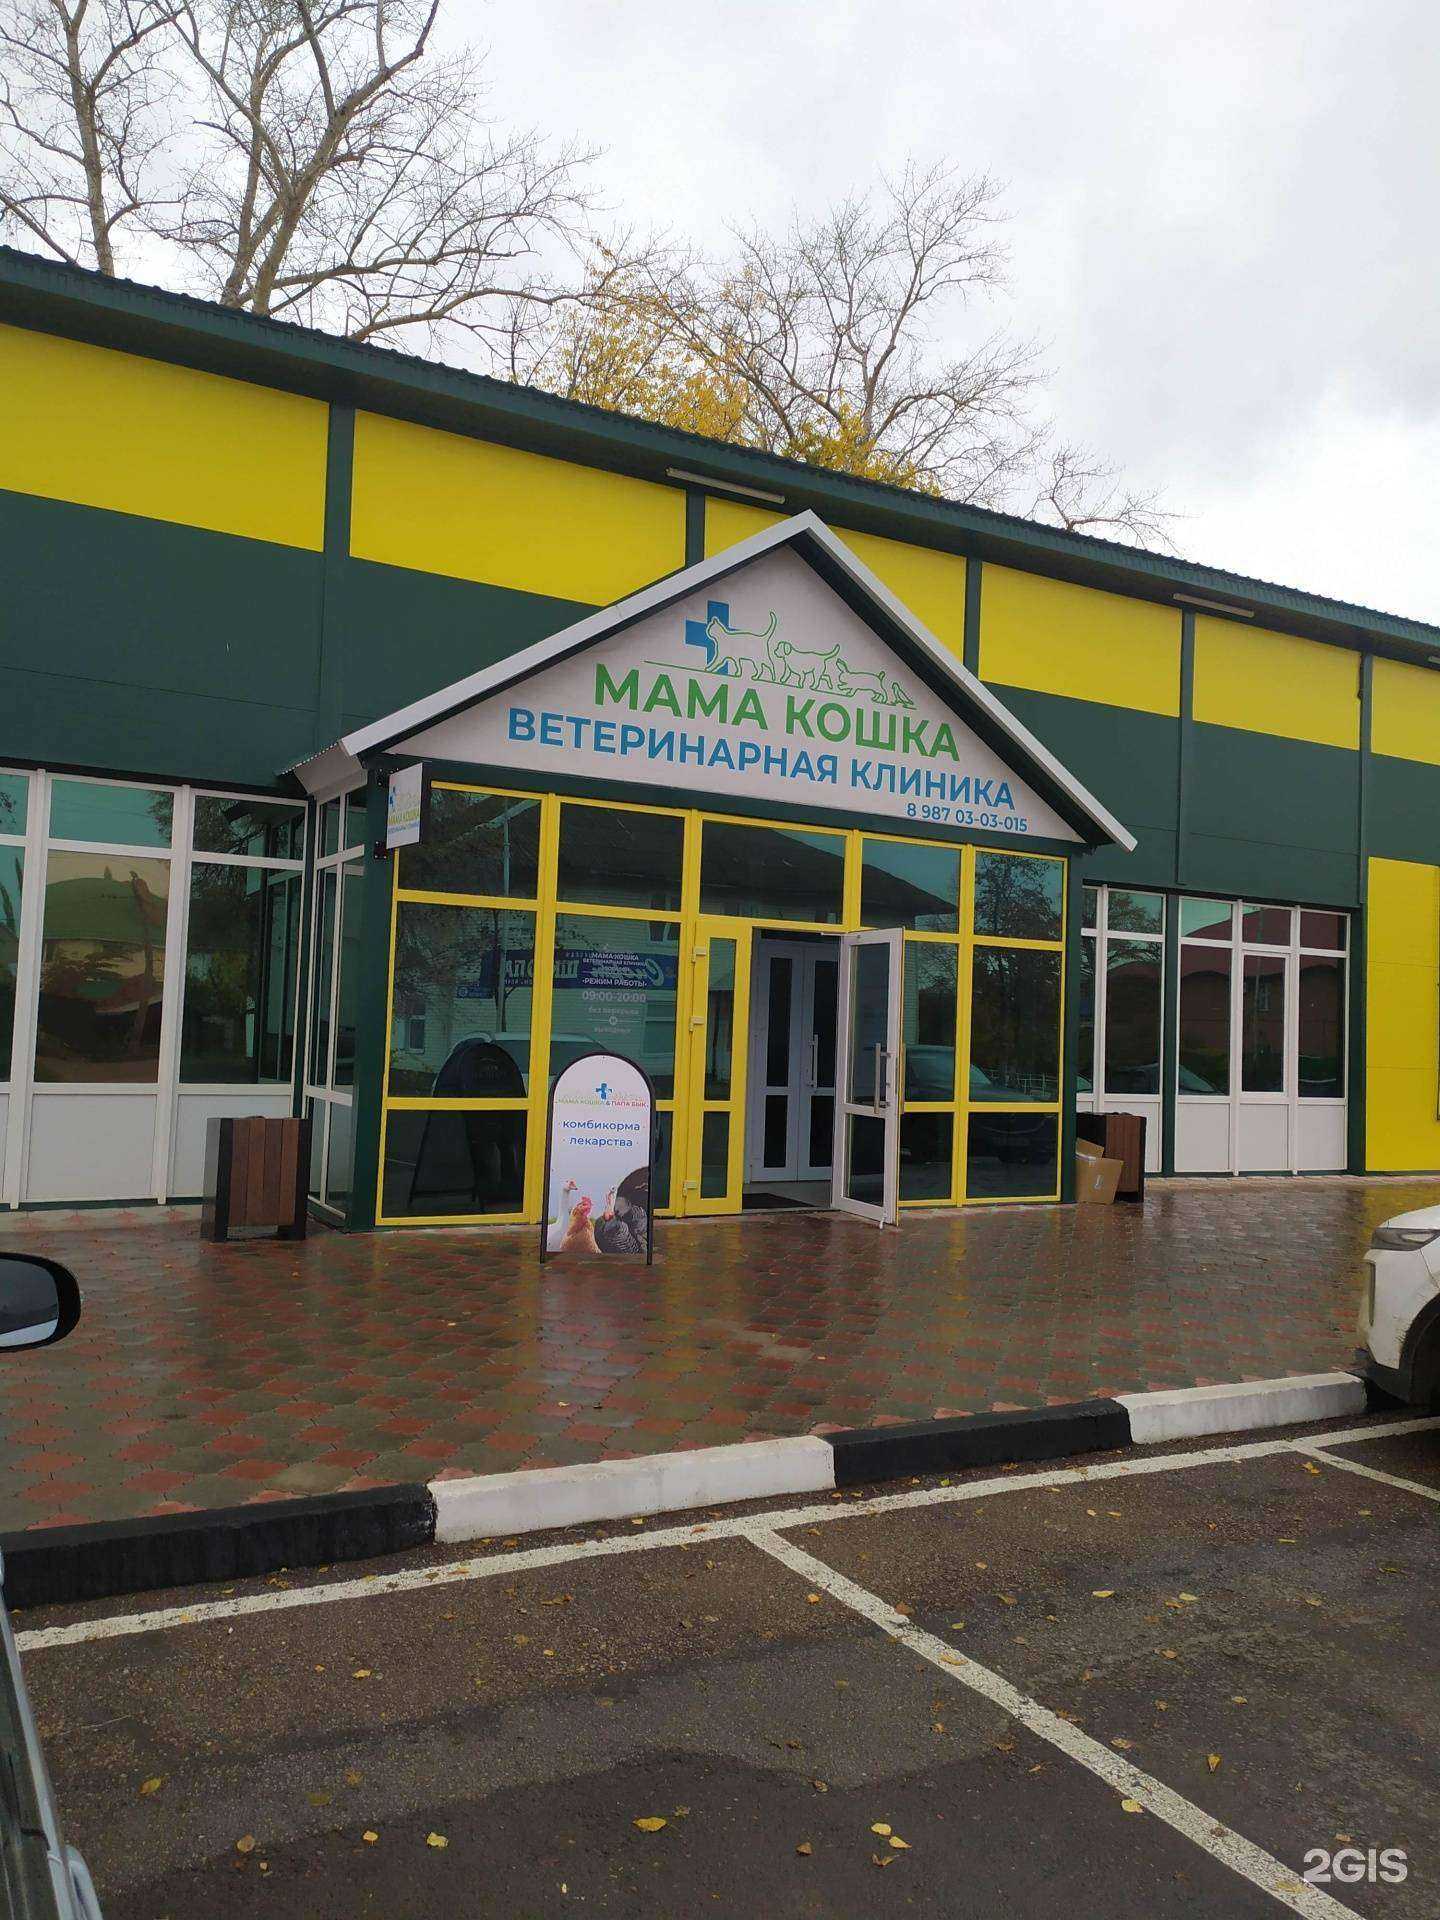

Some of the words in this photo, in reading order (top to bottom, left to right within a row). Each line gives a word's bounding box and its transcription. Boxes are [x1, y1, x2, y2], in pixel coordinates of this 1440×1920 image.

[594, 663, 769, 731] МАМА
[785, 695, 960, 762] КОШКА
[508, 707, 838, 785] ВЕТЕРИНАРНАЯ
[851, 758, 1015, 810] КЛИНИКА
[907, 803, 917, 817] 8
[922, 804, 950, 821] 987
[955, 810, 1028, 832] 03-03-015
[563, 1120, 640, 1132] комбикорма
[569, 1137, 633, 1147] лекарства
